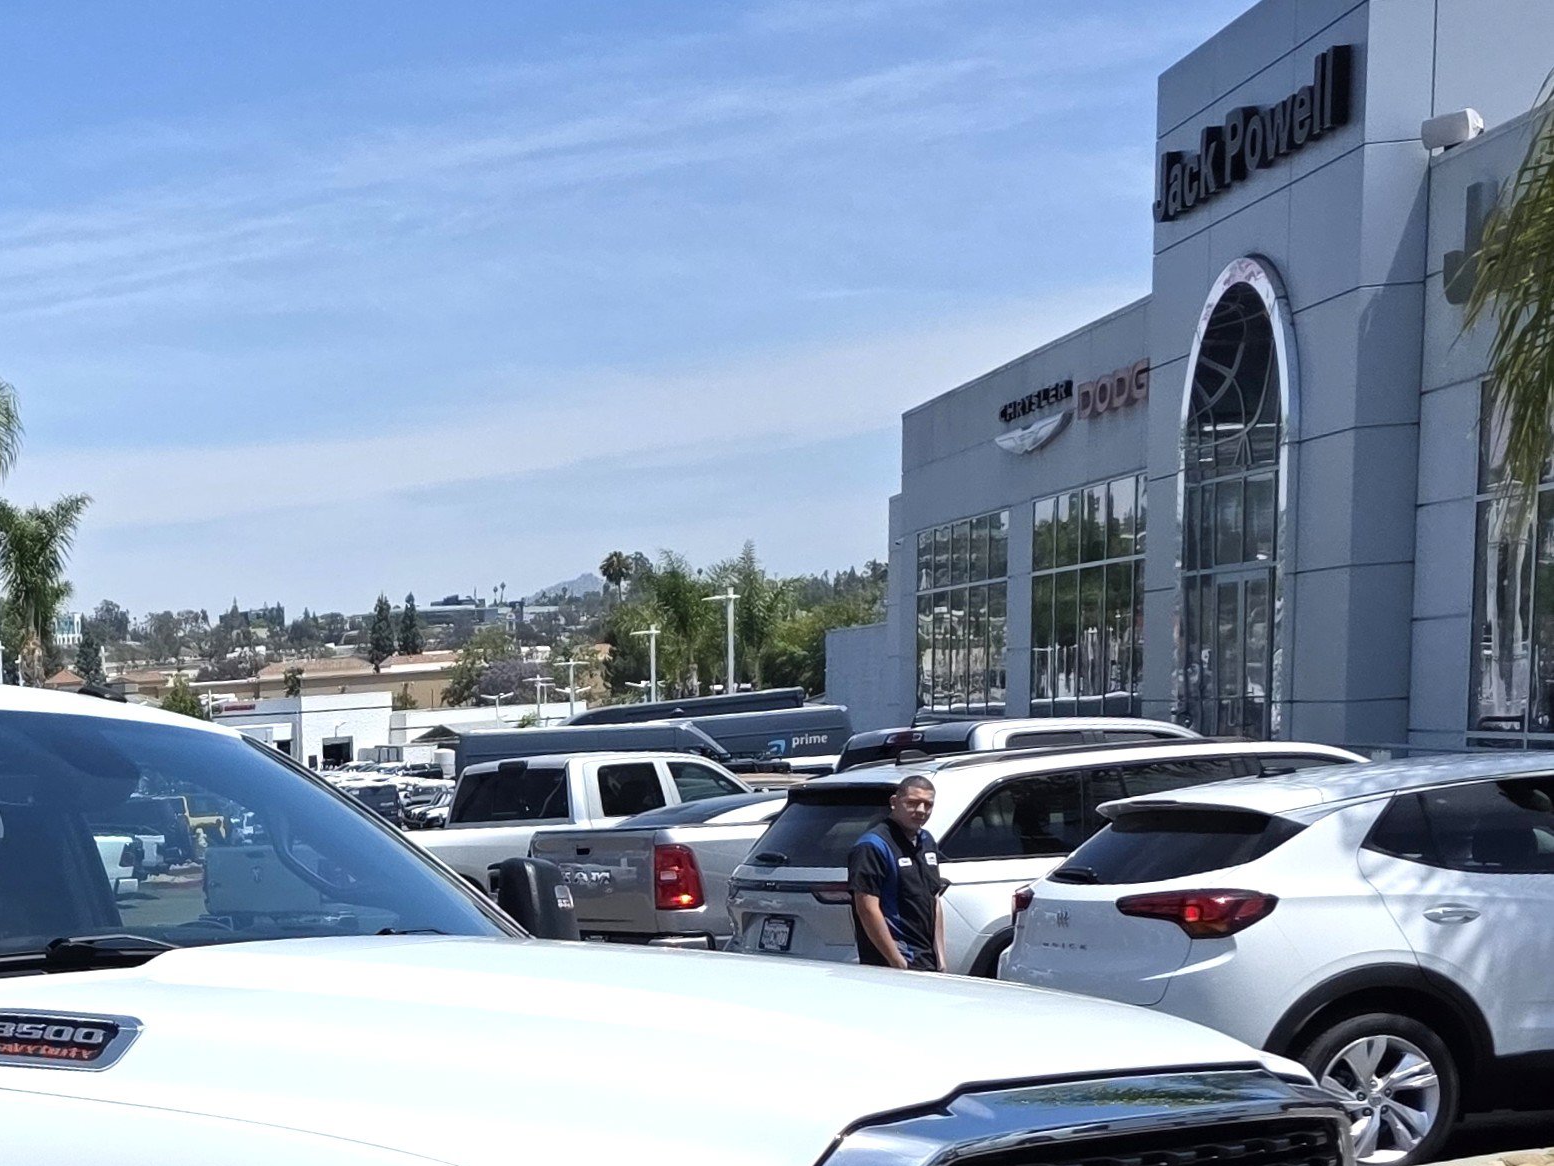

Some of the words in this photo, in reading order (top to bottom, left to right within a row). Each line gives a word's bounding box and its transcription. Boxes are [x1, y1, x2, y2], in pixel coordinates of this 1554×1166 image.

[1152, 125, 1221, 222] Jack
[1224, 44, 1346, 182] Powell
[1000, 380, 1073, 421] CHRYSLER
[791, 733, 828, 749] prime
[39, 1046, 98, 1059] DUTY
